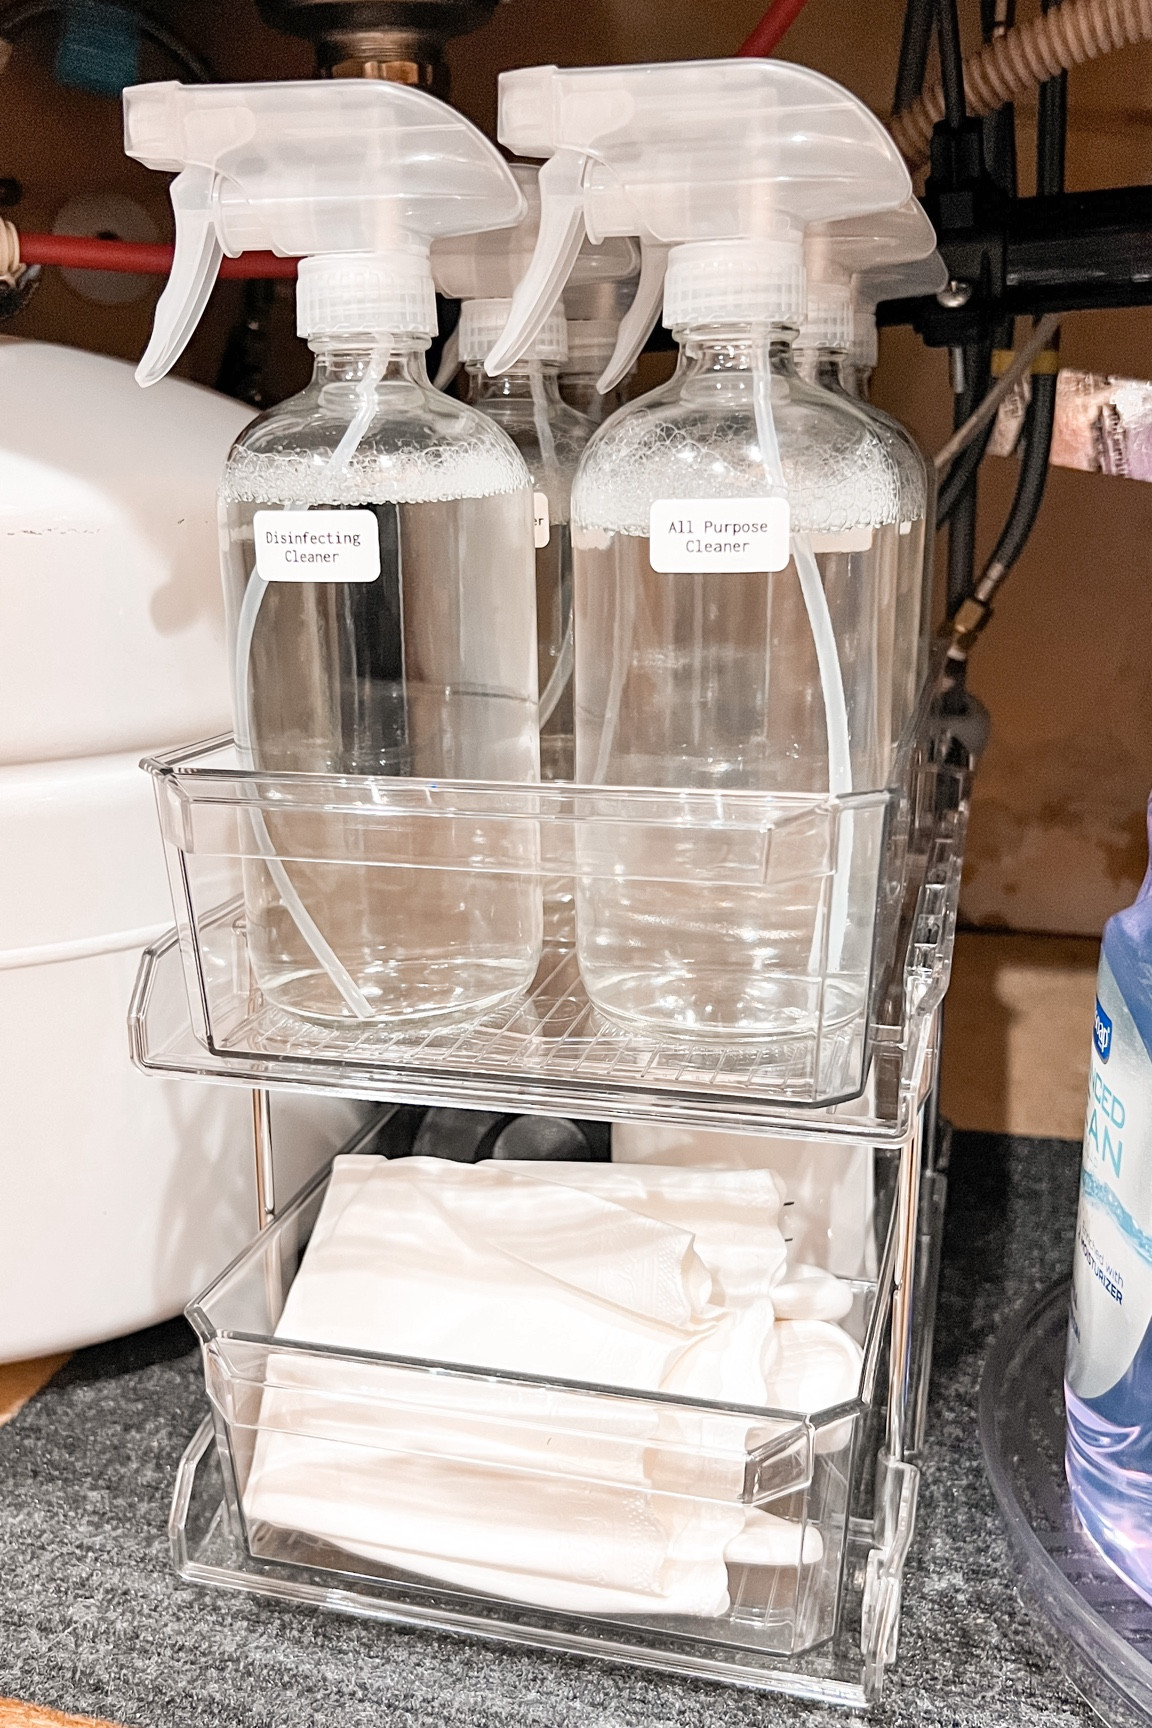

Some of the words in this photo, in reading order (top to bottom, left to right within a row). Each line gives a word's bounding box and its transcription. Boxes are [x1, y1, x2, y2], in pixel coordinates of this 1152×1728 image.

[668, 520, 694, 534] All
[704, 520, 768, 536] Purpose
[265, 531, 361, 547] Disinfecting
[685, 539, 750, 553] Cleaner
[284, 549, 339, 563] Cleaner
[1106, 1263, 1124, 1288] with
